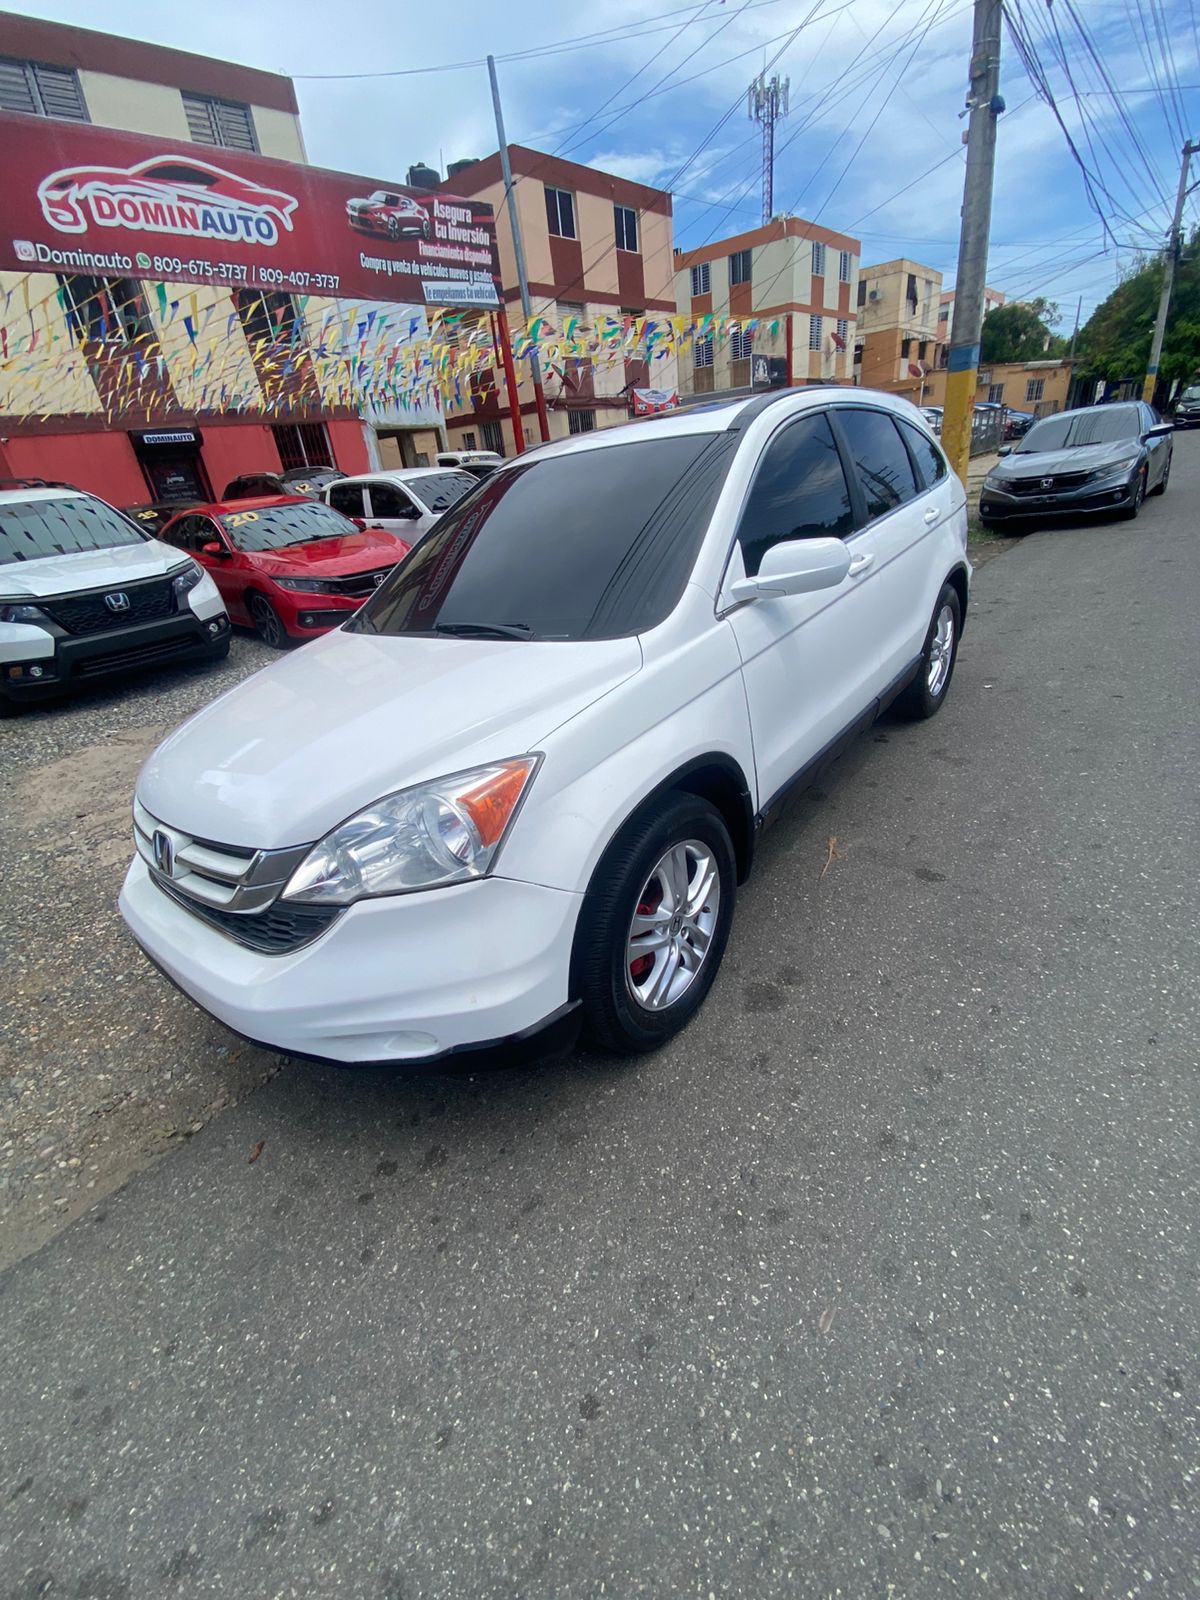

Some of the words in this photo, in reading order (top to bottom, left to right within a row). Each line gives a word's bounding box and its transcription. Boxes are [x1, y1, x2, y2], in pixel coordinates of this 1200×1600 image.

[93, 193, 274, 240] DOMINAUTO
[434, 199, 472, 226] Asegura
[435, 221, 447, 239] tu
[448, 222, 490, 246] Inversión
[418, 240, 464, 260] Financiamiento
[36, 244, 132, 269] Dominauto
[154, 256, 247, 280] 809-675-3737
[259, 268, 339, 289] 809-407-3737
[360, 252, 386, 275] Compra
[387, 260, 392, 276] y
[392, 259, 411, 274] venta
[411, 260, 420, 275] de
[469, 270, 474, 286] y
[146, 434, 193, 443] DOMINAUTO
[295, 483, 313, 494] 12
[225, 511, 259, 527] 20
